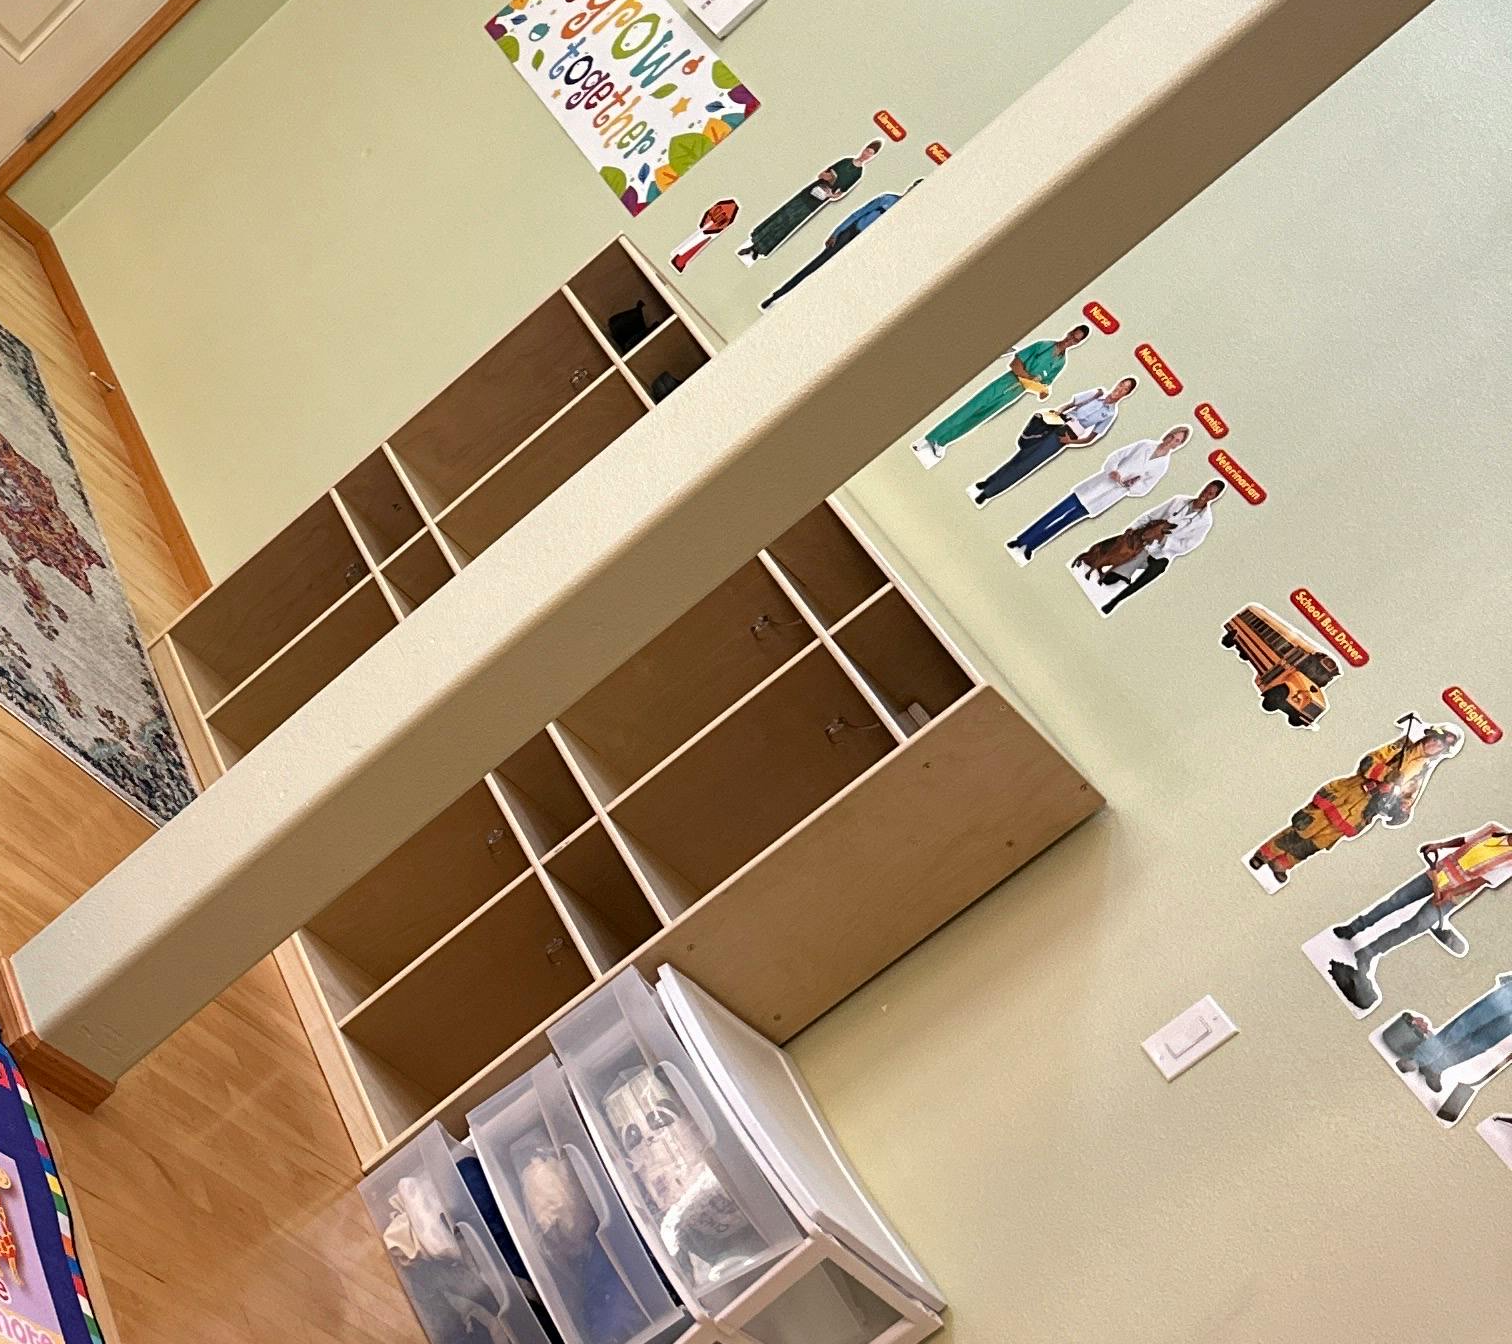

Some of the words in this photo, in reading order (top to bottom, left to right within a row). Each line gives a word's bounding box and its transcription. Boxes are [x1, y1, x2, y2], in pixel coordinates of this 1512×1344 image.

[549, 36, 656, 160] together
[1089, 306, 1112, 327] Nurse
[1199, 406, 1224, 435] Dentist
[1215, 452, 1261, 500] Veterinarian
[1295, 591, 1323, 622] School
[1320, 617, 1337, 637] Bus
[1334, 631, 1364, 662] Driver
[1448, 688, 1496, 736] Firefighter
